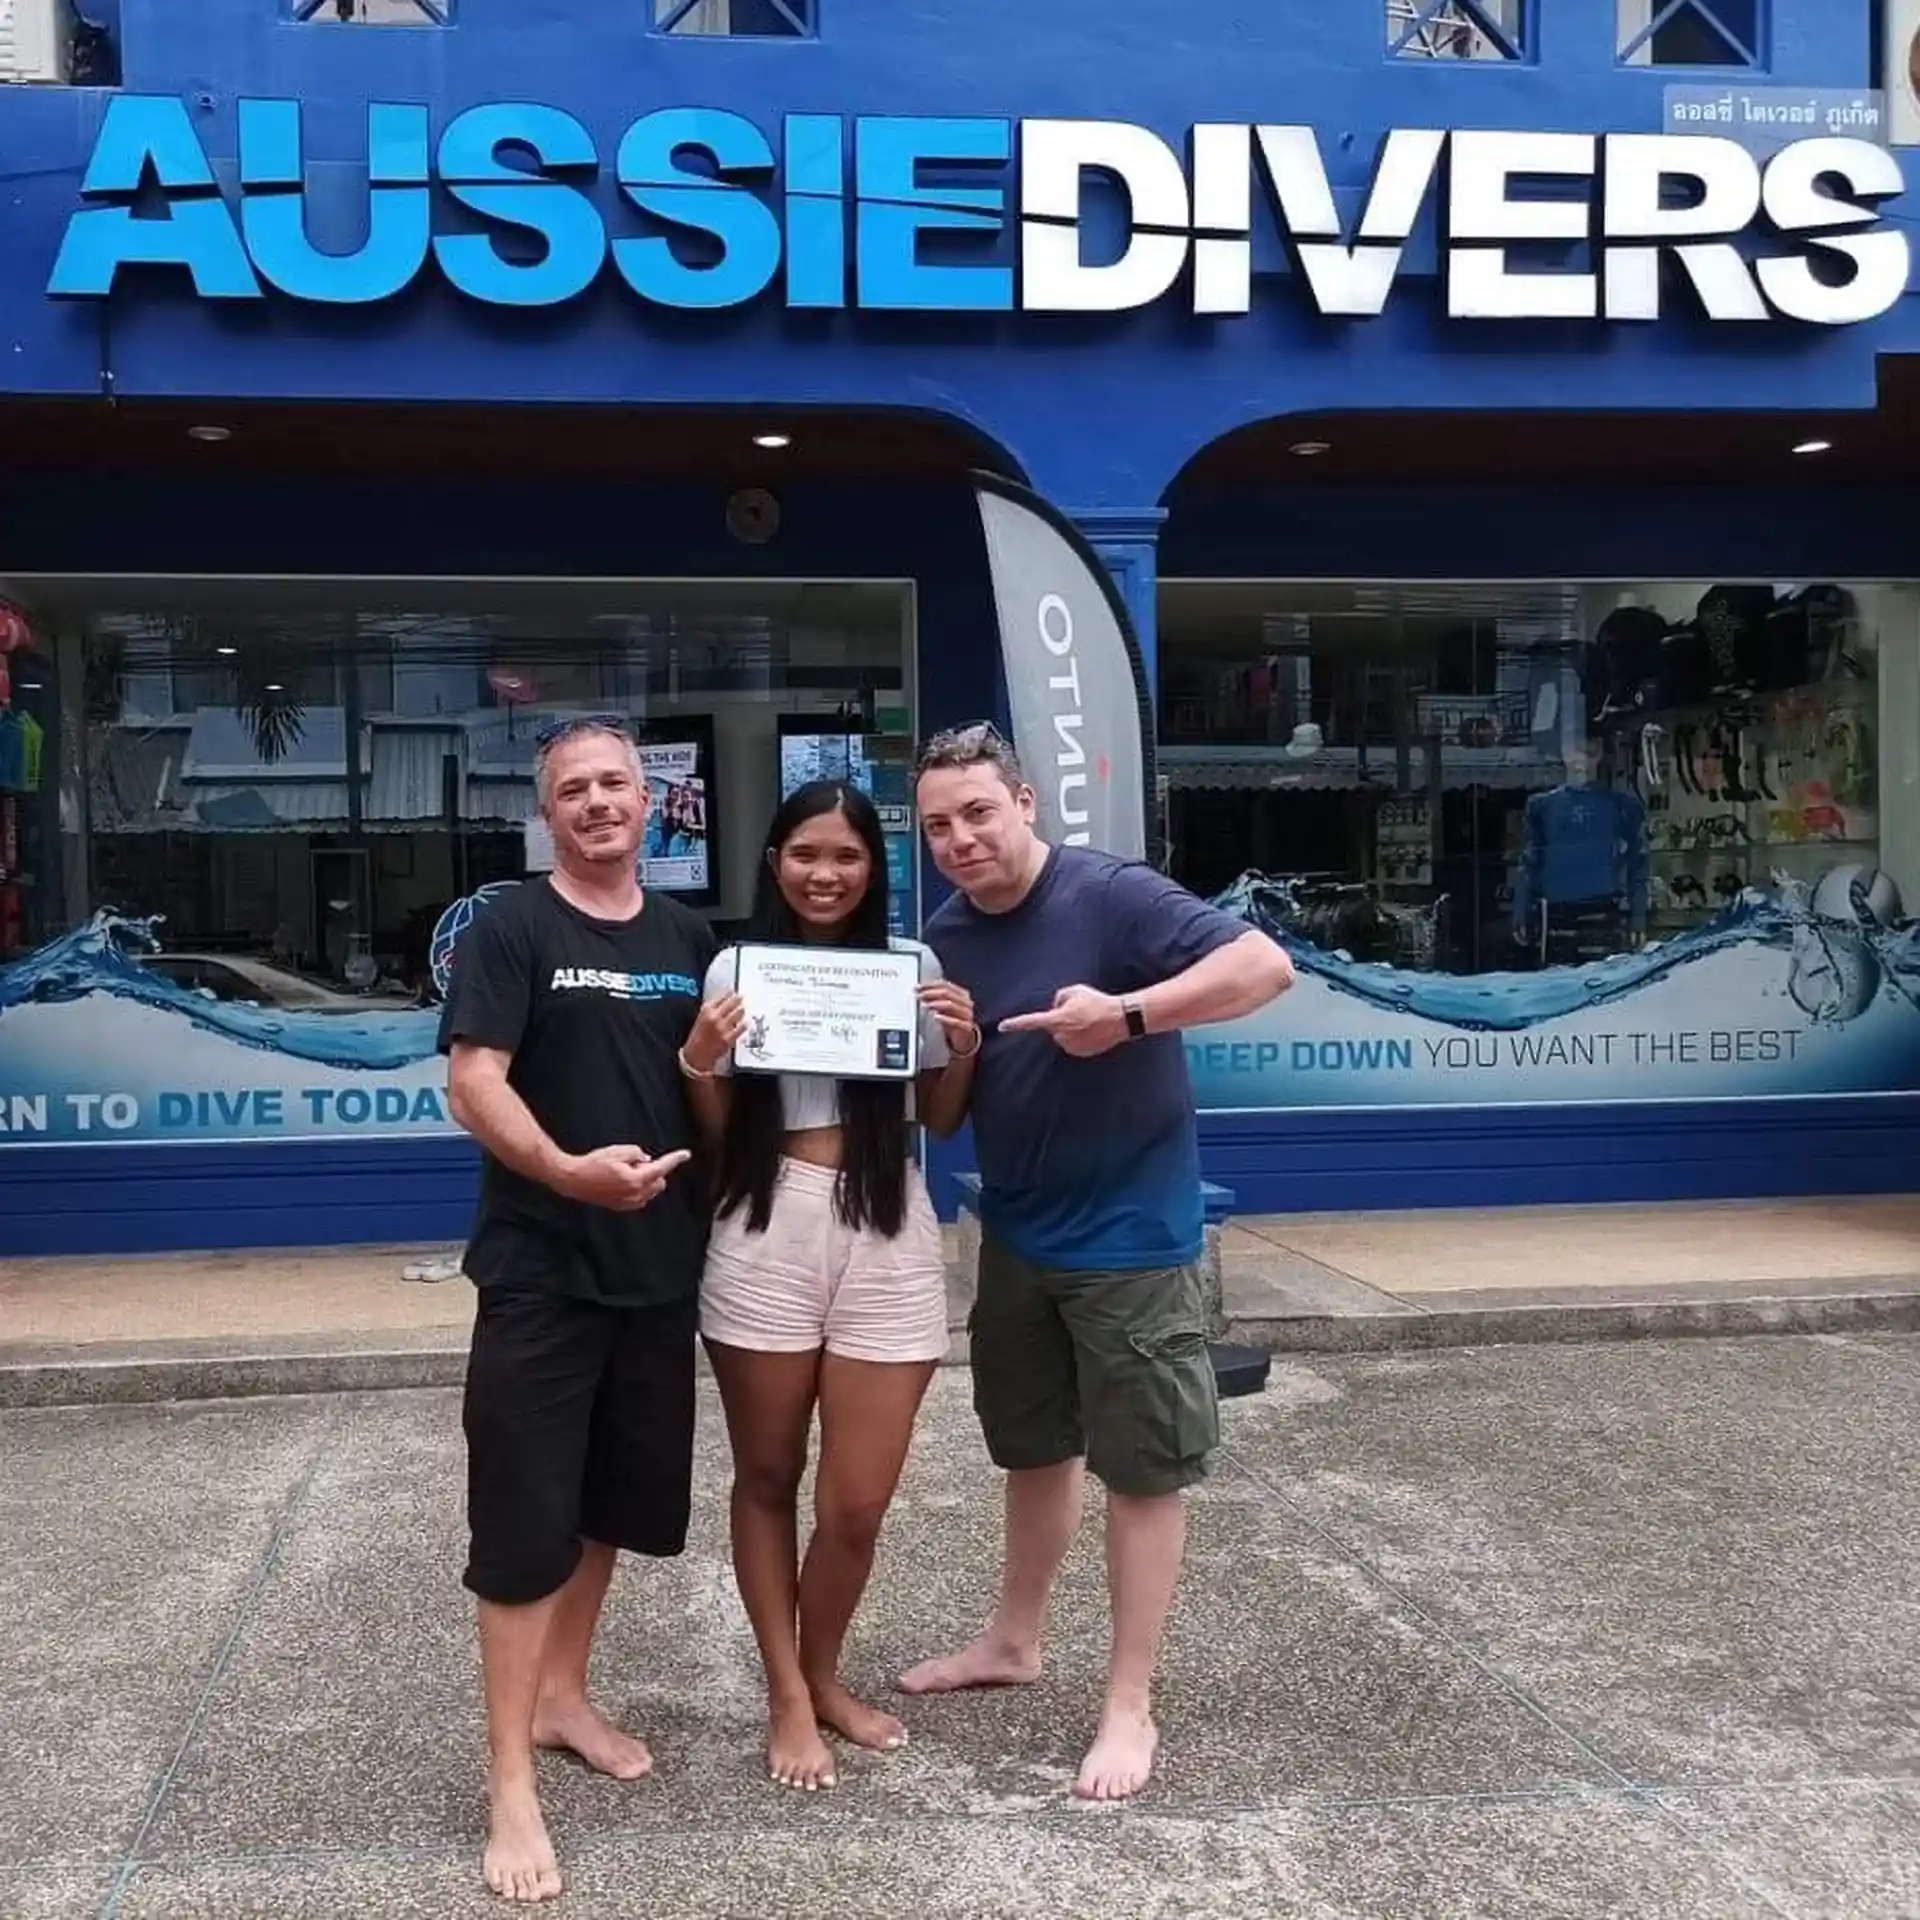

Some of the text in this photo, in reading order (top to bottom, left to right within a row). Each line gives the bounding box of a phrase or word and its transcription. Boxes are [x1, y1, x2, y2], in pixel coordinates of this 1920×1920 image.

[1291, 1038, 1412, 1070] DOWN
[1424, 1036, 1498, 1067] YOU
[1510, 1034, 1618, 1066] WANT
[1627, 1032, 1699, 1063] THE
[1710, 1029, 1803, 1061] BEST
[66, 1092, 139, 1129] TO
[159, 1089, 283, 1127] DIVE
[302, 1086, 448, 1124] TODA
